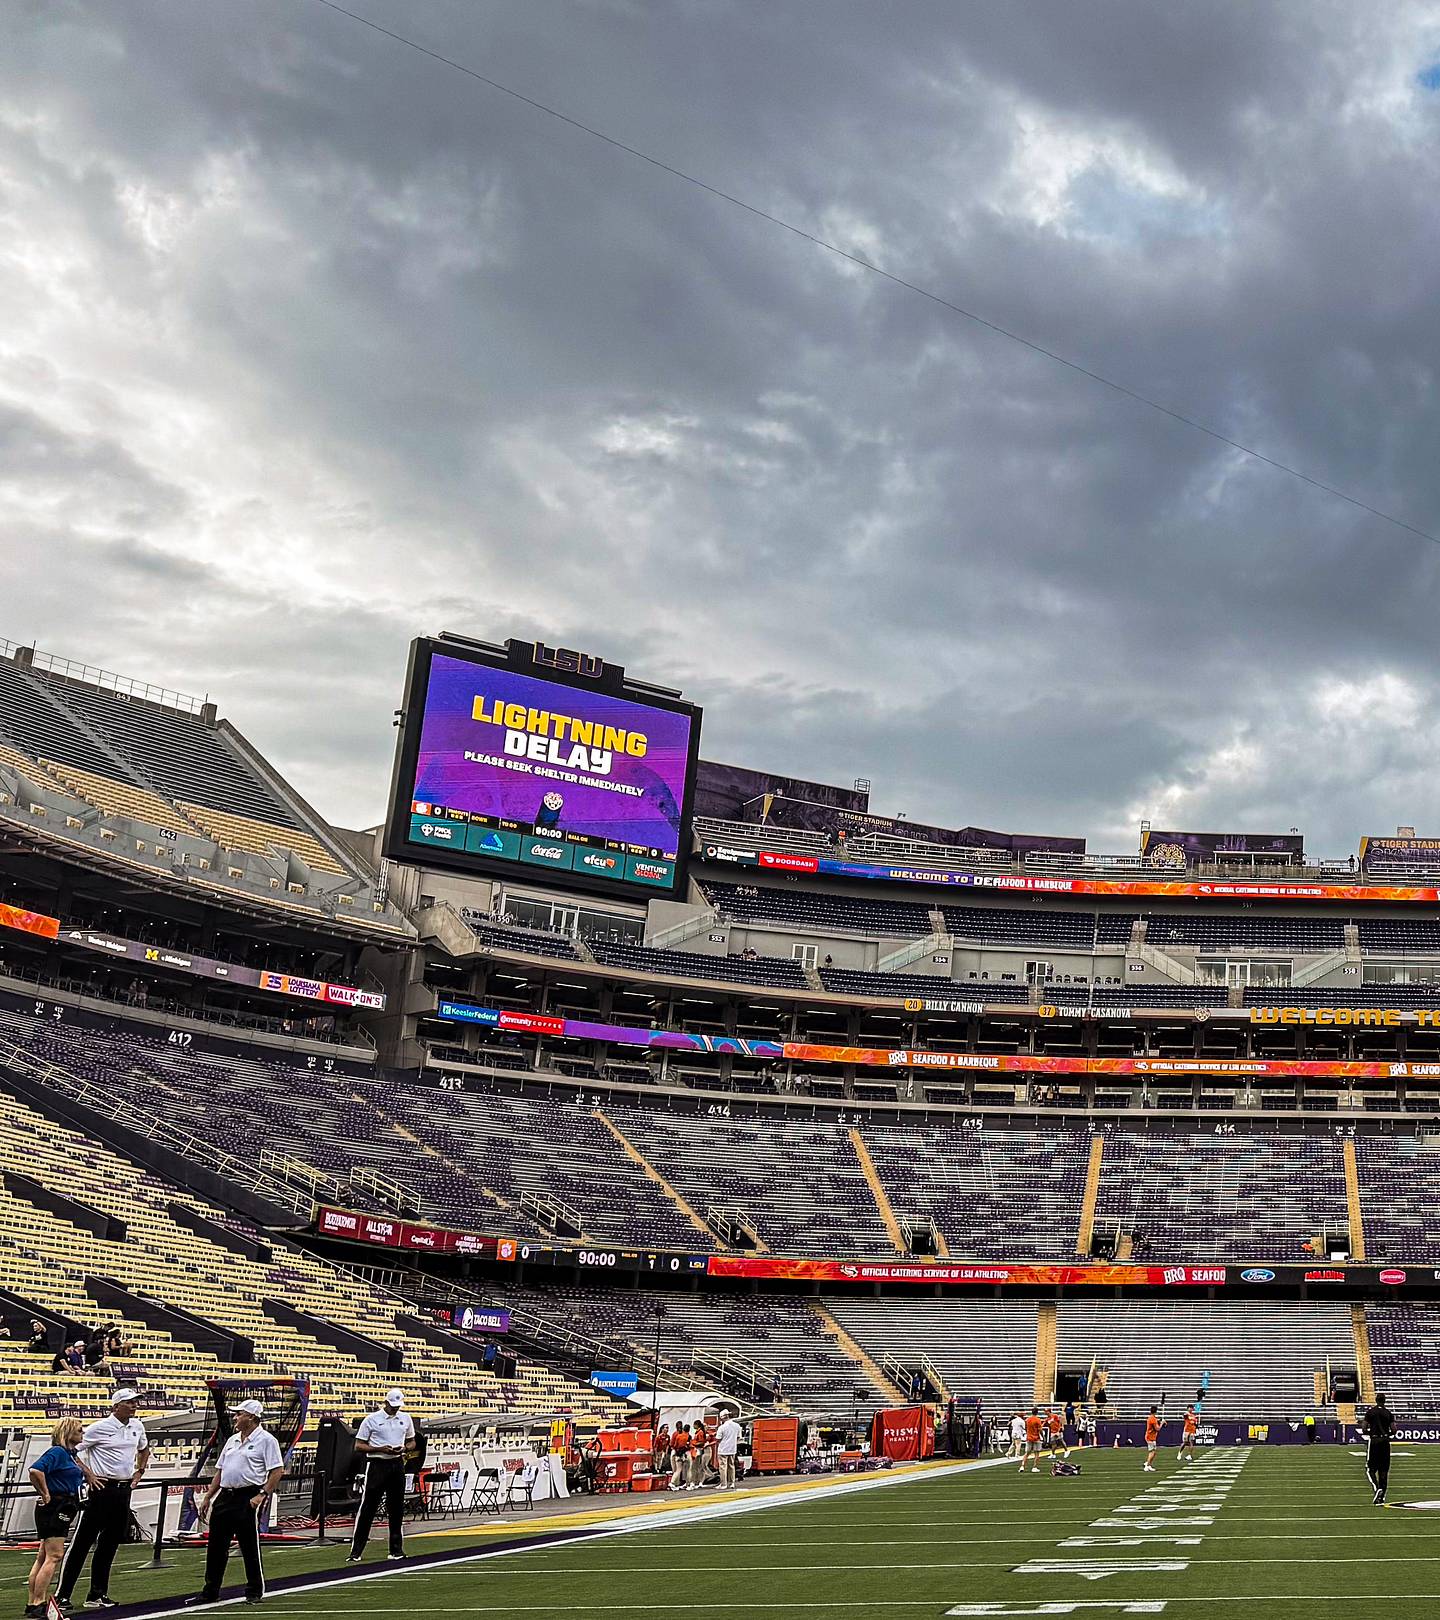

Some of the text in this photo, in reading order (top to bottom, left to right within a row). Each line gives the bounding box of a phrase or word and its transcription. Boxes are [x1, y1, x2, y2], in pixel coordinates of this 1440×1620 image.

[532, 641, 603, 679] LSU
[116, 691, 130, 702] 643
[471, 695, 648, 759] LIGHTNING
[503, 729, 613, 775] DELAY
[463, 750, 644, 797] PLEASE SEEK SHELTER IMMEDIATELY
[844, 812, 863, 821] TIGER
[863, 816, 892, 827] STADIUM
[160, 829, 176, 840] 642
[535, 826, 563, 839] 90:00
[1378, 840, 1407, 848] TIGER
[636, 862, 667, 875] VENTURE
[775, 857, 814, 867] DOORDASH
[889, 870, 968, 883] WELCOME TO
[1034, 878, 1072, 890] BARBEQUE
[288, 977, 321, 992] LOUISIANA
[289, 985, 319, 997] LOTTERY
[908, 1000, 983, 1013] 20 BILLY CANNON
[1041, 1006, 1131, 1018] 37 TOMMY CASANOVA
[500, 1014, 561, 1029] Community COFFEE
[1249, 1007, 1401, 1026] WELCOME
[168, 1030, 192, 1047] 412
[912, 1053, 999, 1067] SEAFOOD & BARBEQUE
[439, 1077, 462, 1090] 413
[707, 1104, 730, 1118] 414
[962, 1112, 984, 1129] 415
[521, 1246, 529, 1259] 0
[578, 1251, 616, 1266] 90:00
[649, 1259, 655, 1269] 1
[670, 1258, 680, 1270] 0
[689, 1261, 705, 1269] LSU
[861, 1267, 1008, 1279] OFFICIAL CATERING SERVICE OF LSU ATHLETICS
[1163, 1266, 1186, 1284] BRQ
[1247, 1271, 1268, 1281] Ford
[474, 1314, 502, 1327] TACO BELL
[883, 1427, 919, 1437] PRISMA
